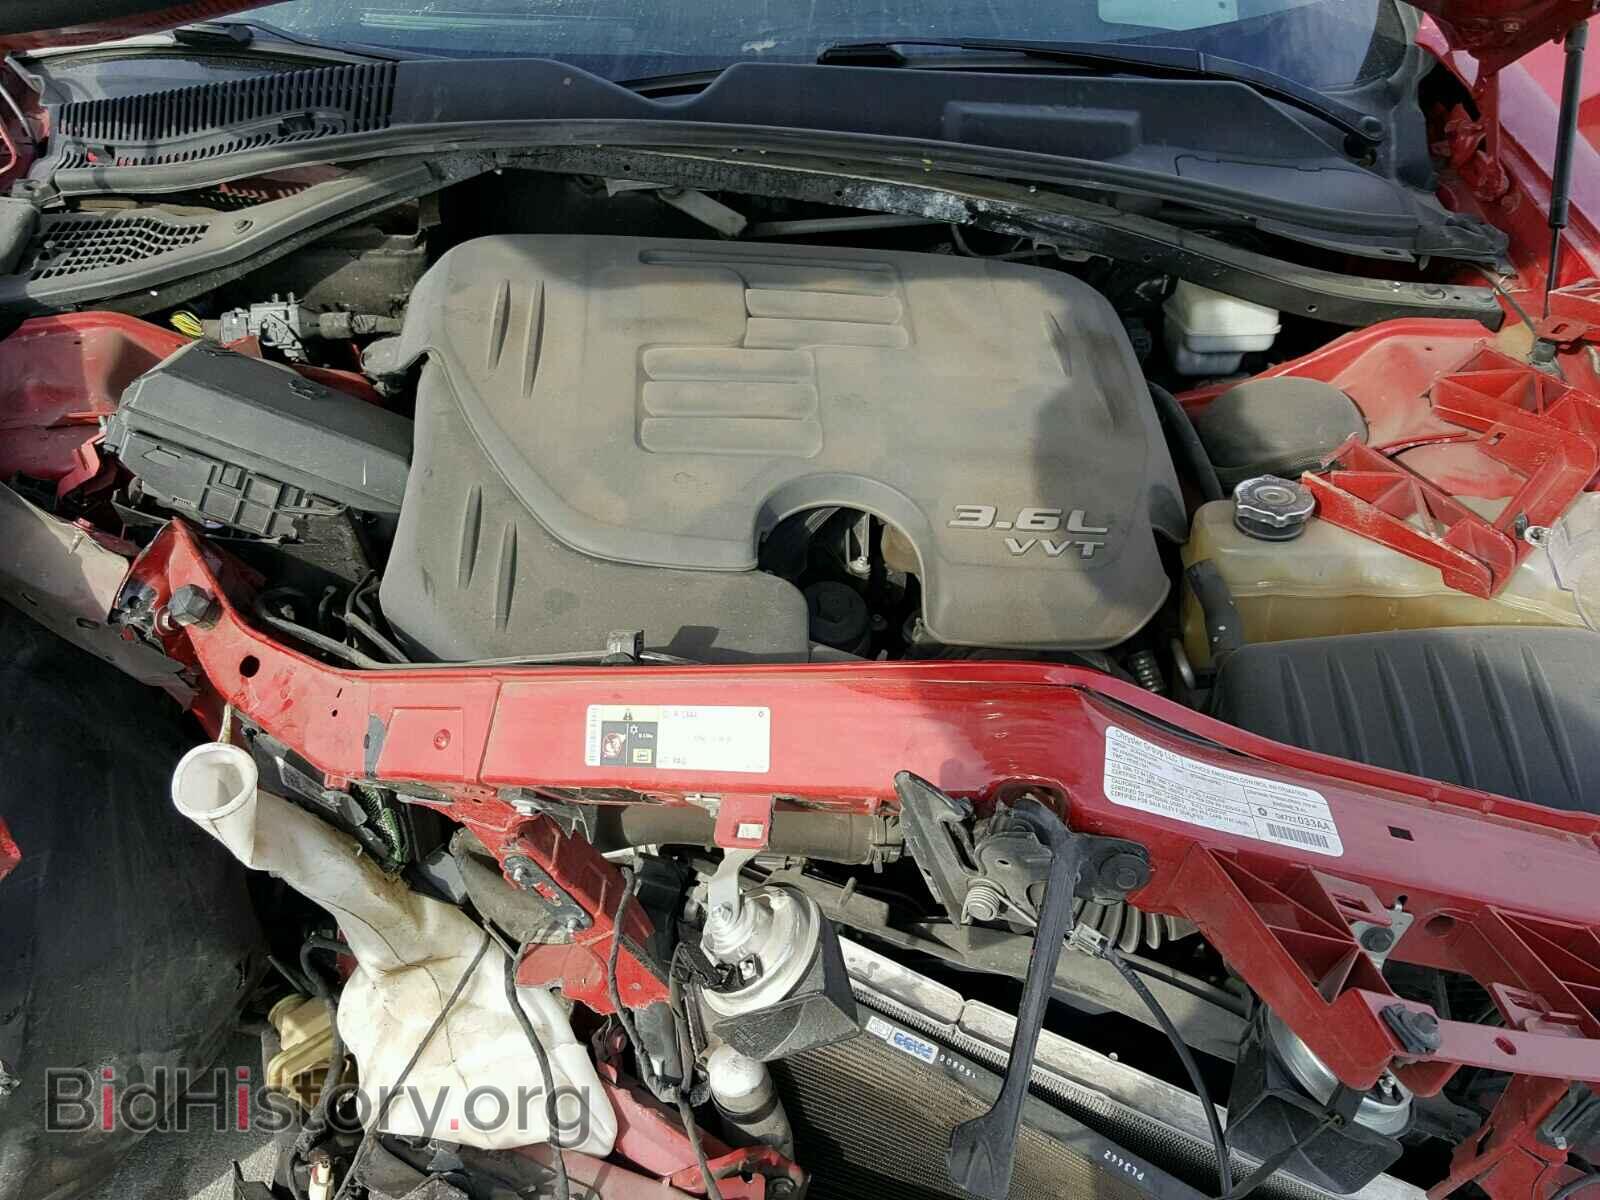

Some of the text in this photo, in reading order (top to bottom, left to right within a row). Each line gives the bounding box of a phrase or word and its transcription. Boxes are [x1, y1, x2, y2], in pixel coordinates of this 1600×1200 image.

[948, 504, 1109, 534] 3.6L
[1005, 537, 1105, 559] VVT
[1115, 729, 1143, 747] Chrysler
